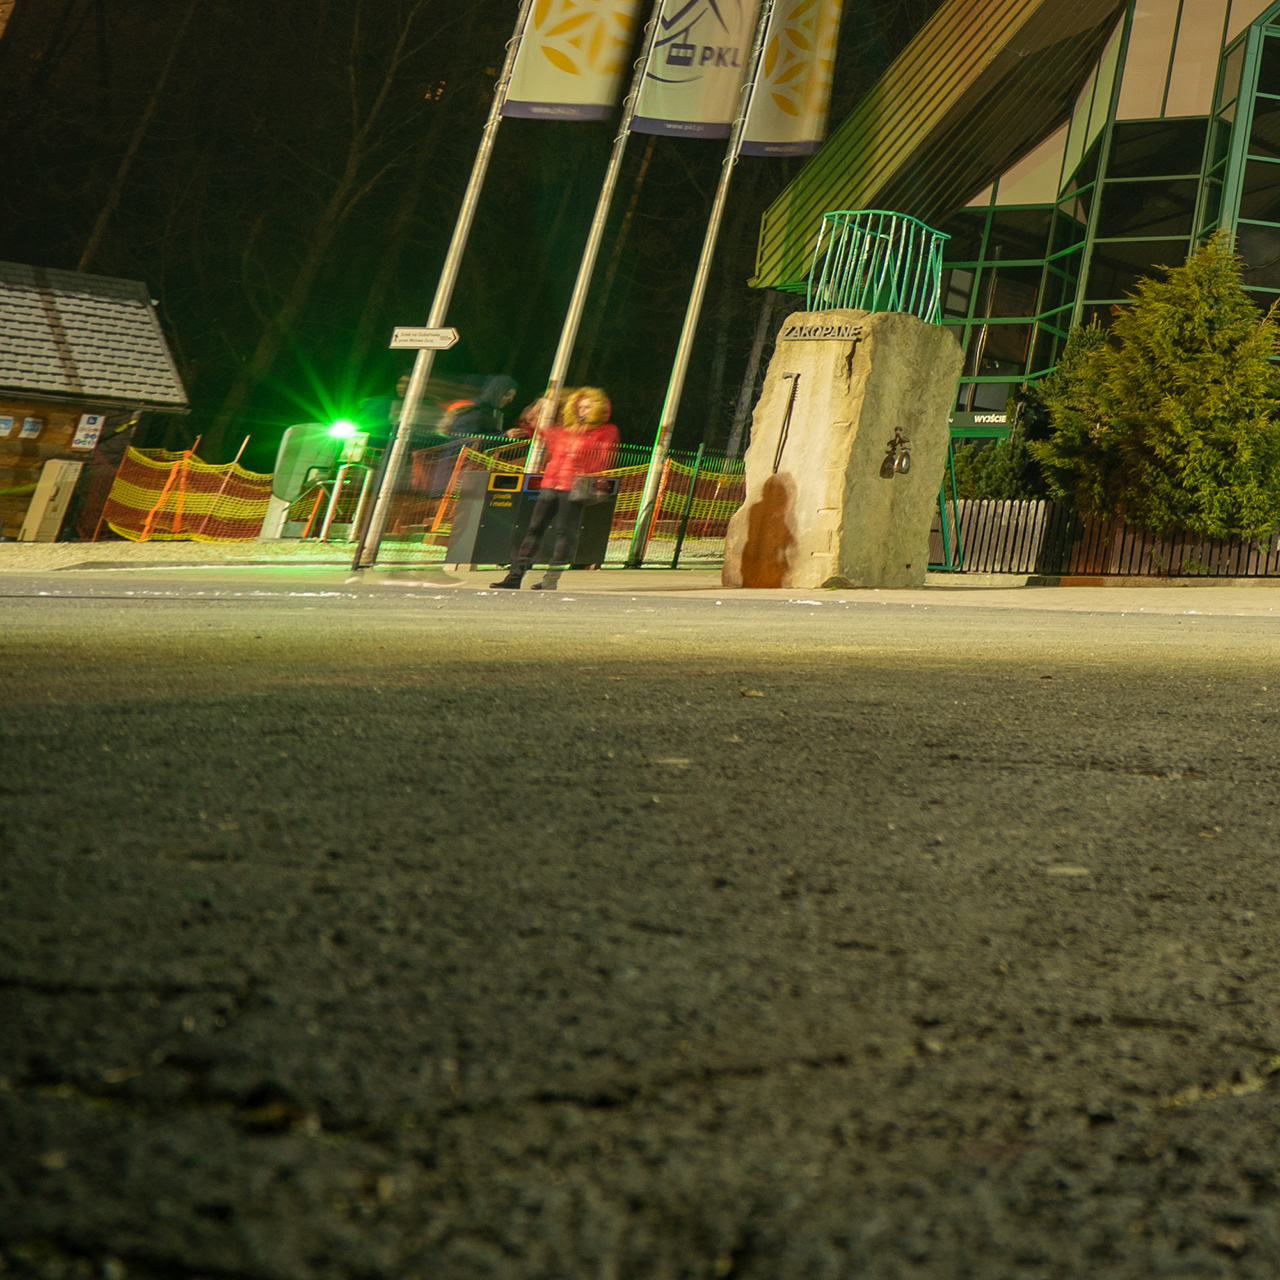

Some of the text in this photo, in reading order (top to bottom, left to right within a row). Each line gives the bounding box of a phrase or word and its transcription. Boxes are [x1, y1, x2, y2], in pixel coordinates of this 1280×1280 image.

[699, 45, 740, 68] PKL
[784, 325, 863, 338] ZAKOPANE
[974, 414, 1007, 423] WYJŚCIE
